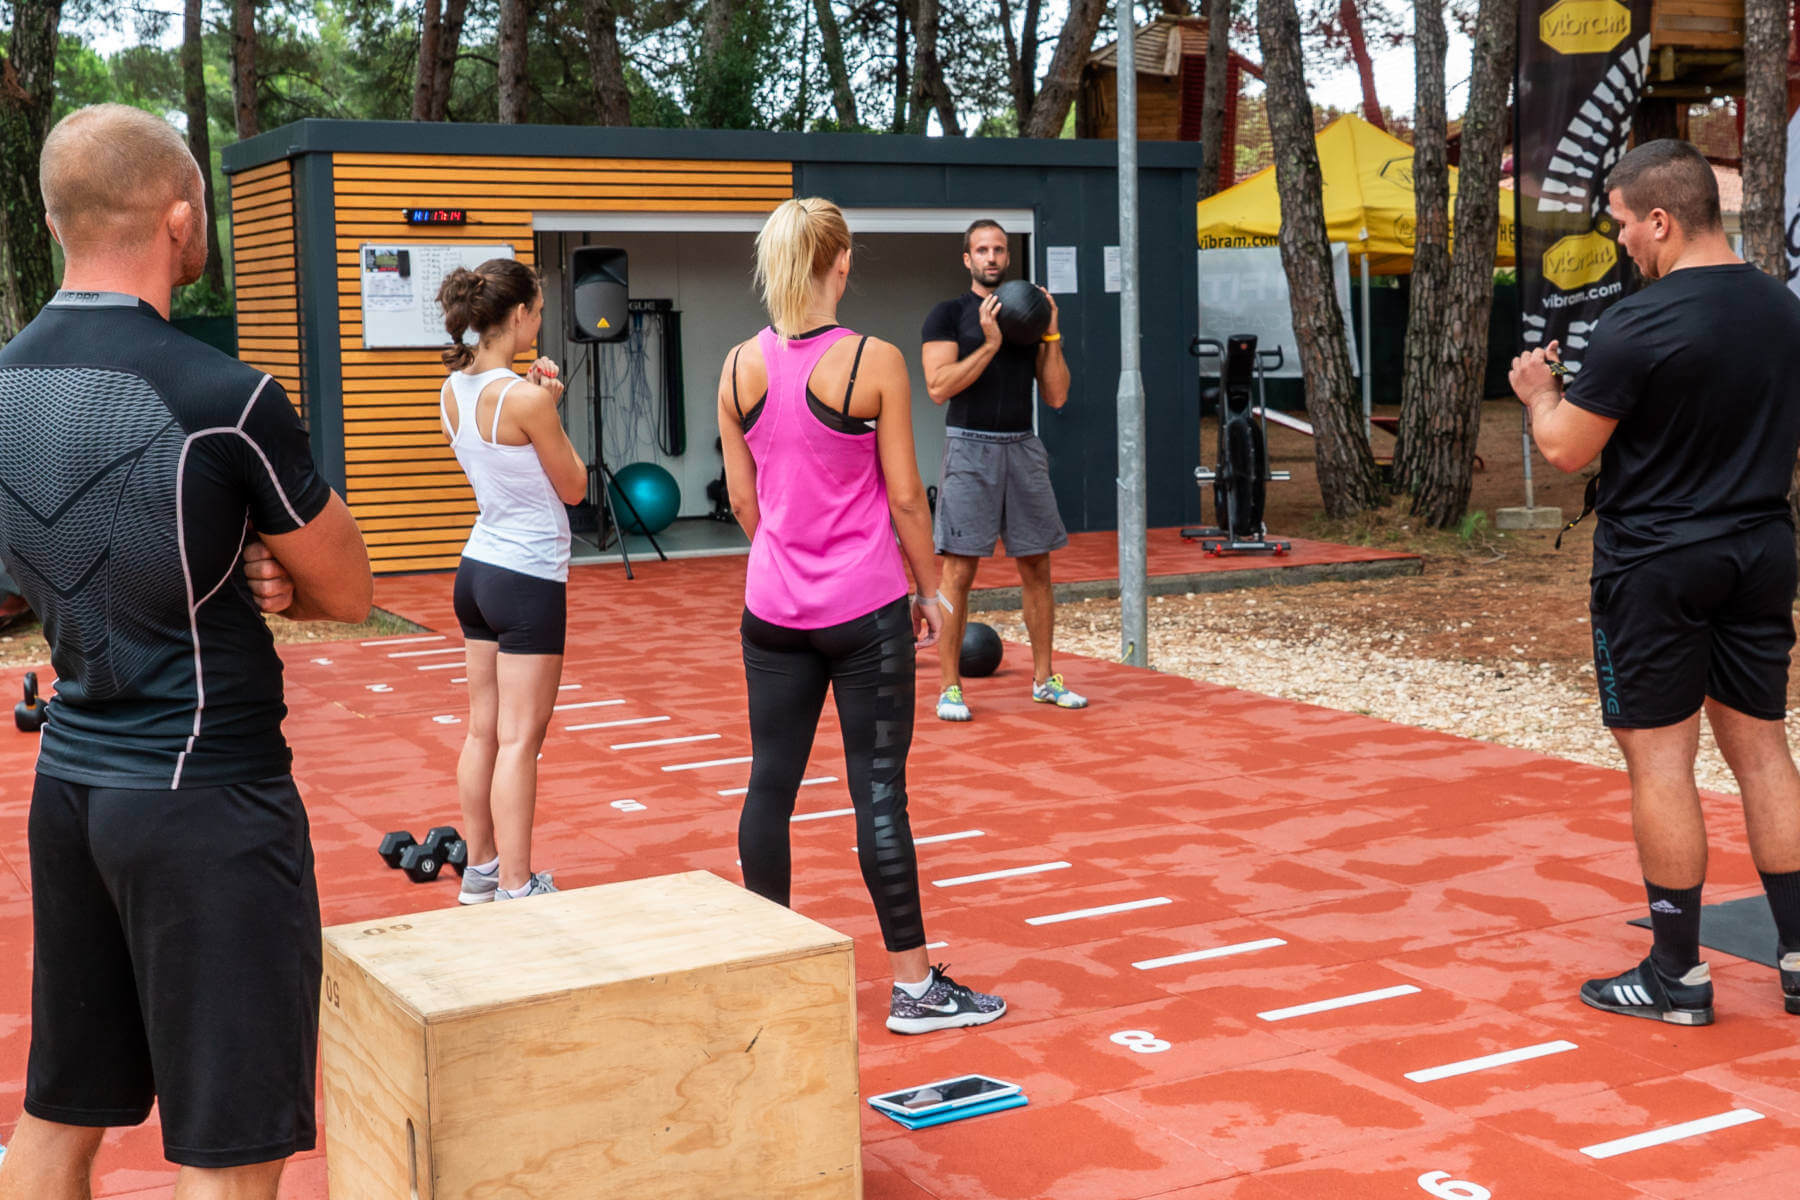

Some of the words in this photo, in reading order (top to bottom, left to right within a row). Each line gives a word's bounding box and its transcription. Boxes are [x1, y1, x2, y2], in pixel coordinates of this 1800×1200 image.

[434, 210, 461, 221] 17:14
[629, 301, 656, 310] GUE
[1542, 281, 1622, 308] vibram.com
[1595, 628, 1620, 714] ACTIVE
[1109, 1029, 1172, 1054] 8
